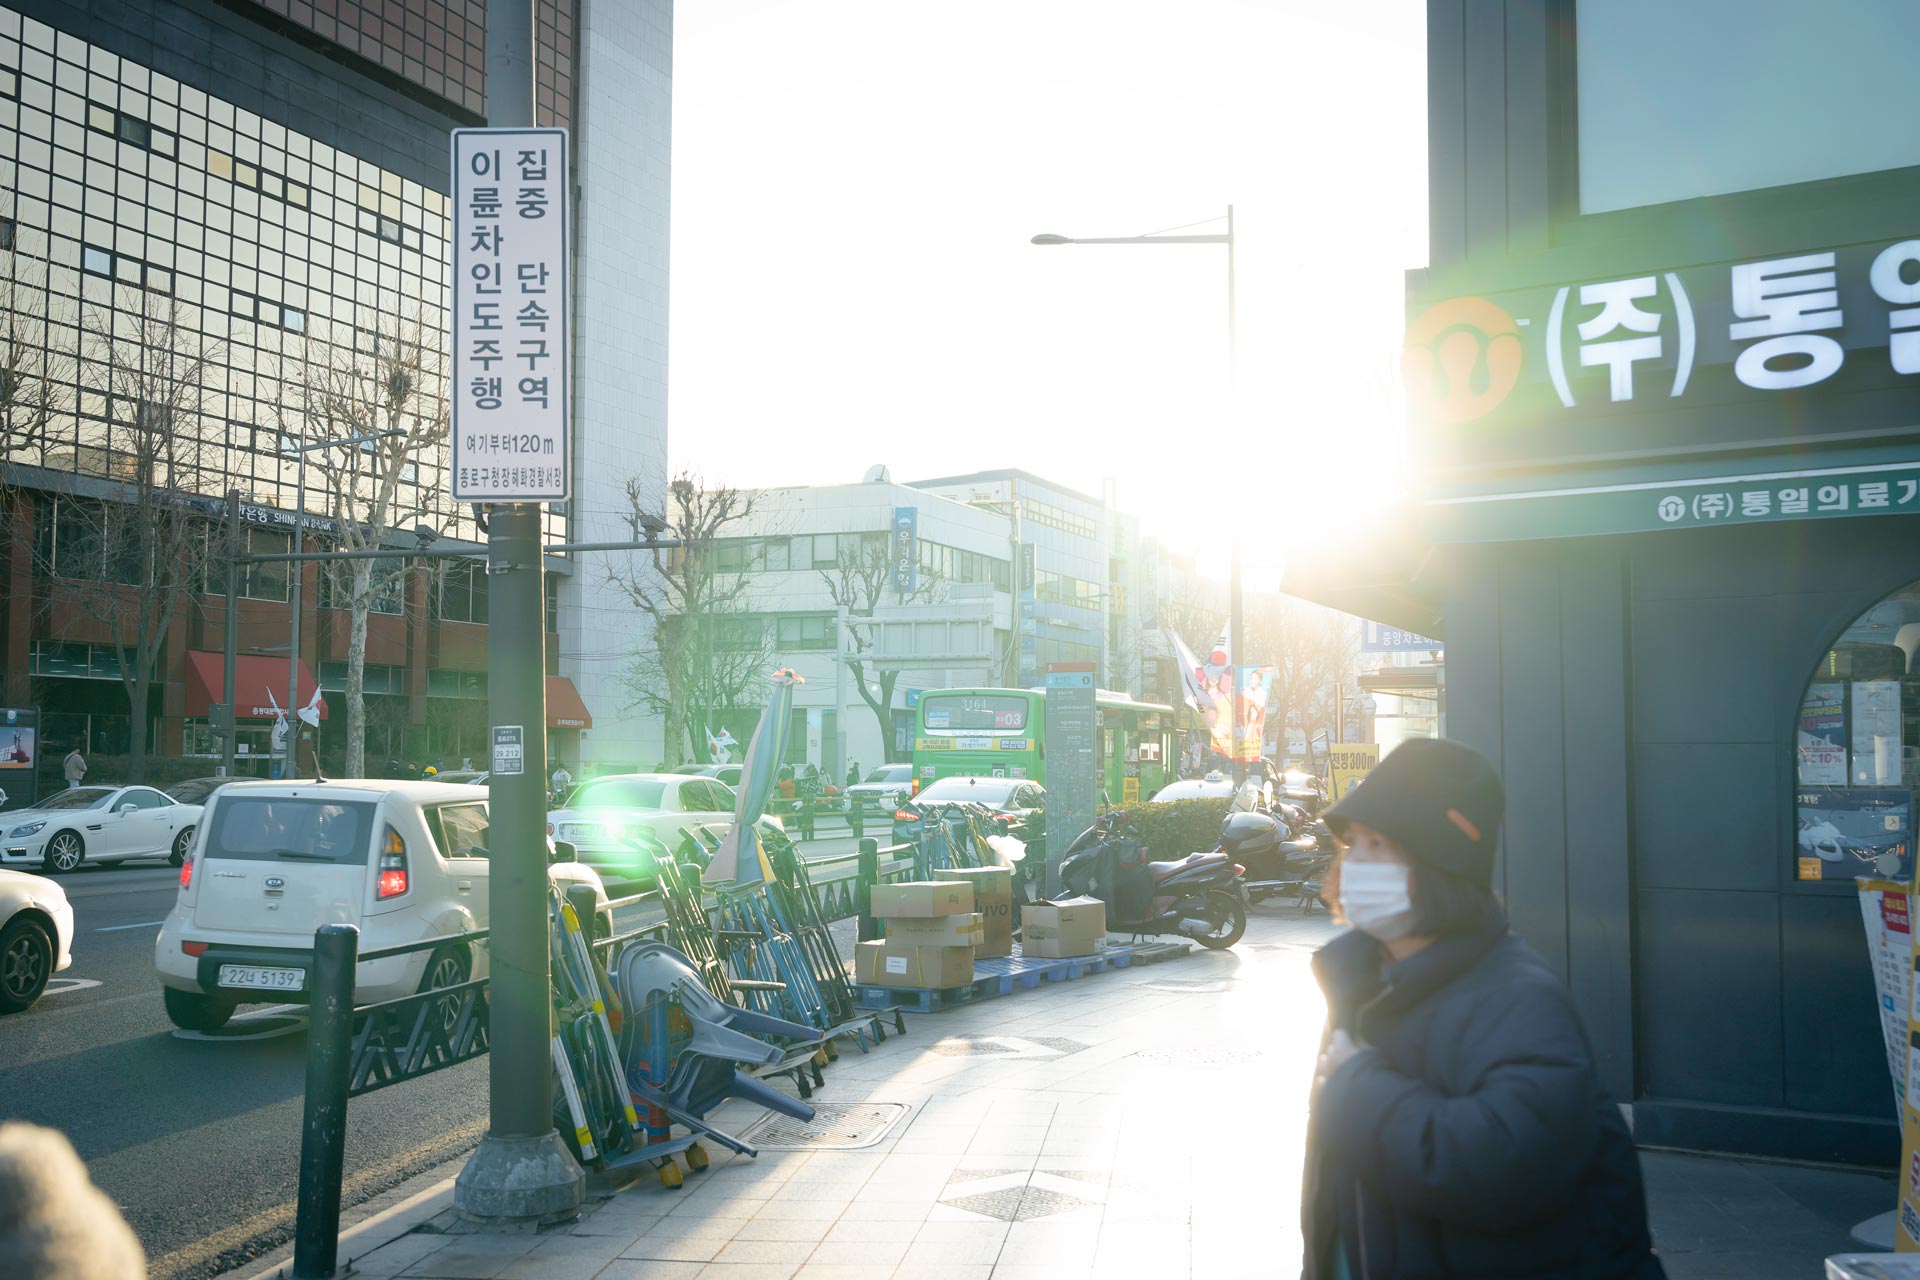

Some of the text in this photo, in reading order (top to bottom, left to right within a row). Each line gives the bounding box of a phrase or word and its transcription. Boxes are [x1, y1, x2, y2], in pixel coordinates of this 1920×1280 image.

[469, 149, 504, 410] 이륜차인도주행
[516, 149, 550, 409] 집중 단속구역
[961, 699, 987, 709] 3164
[260, 971, 295, 986] 5139
